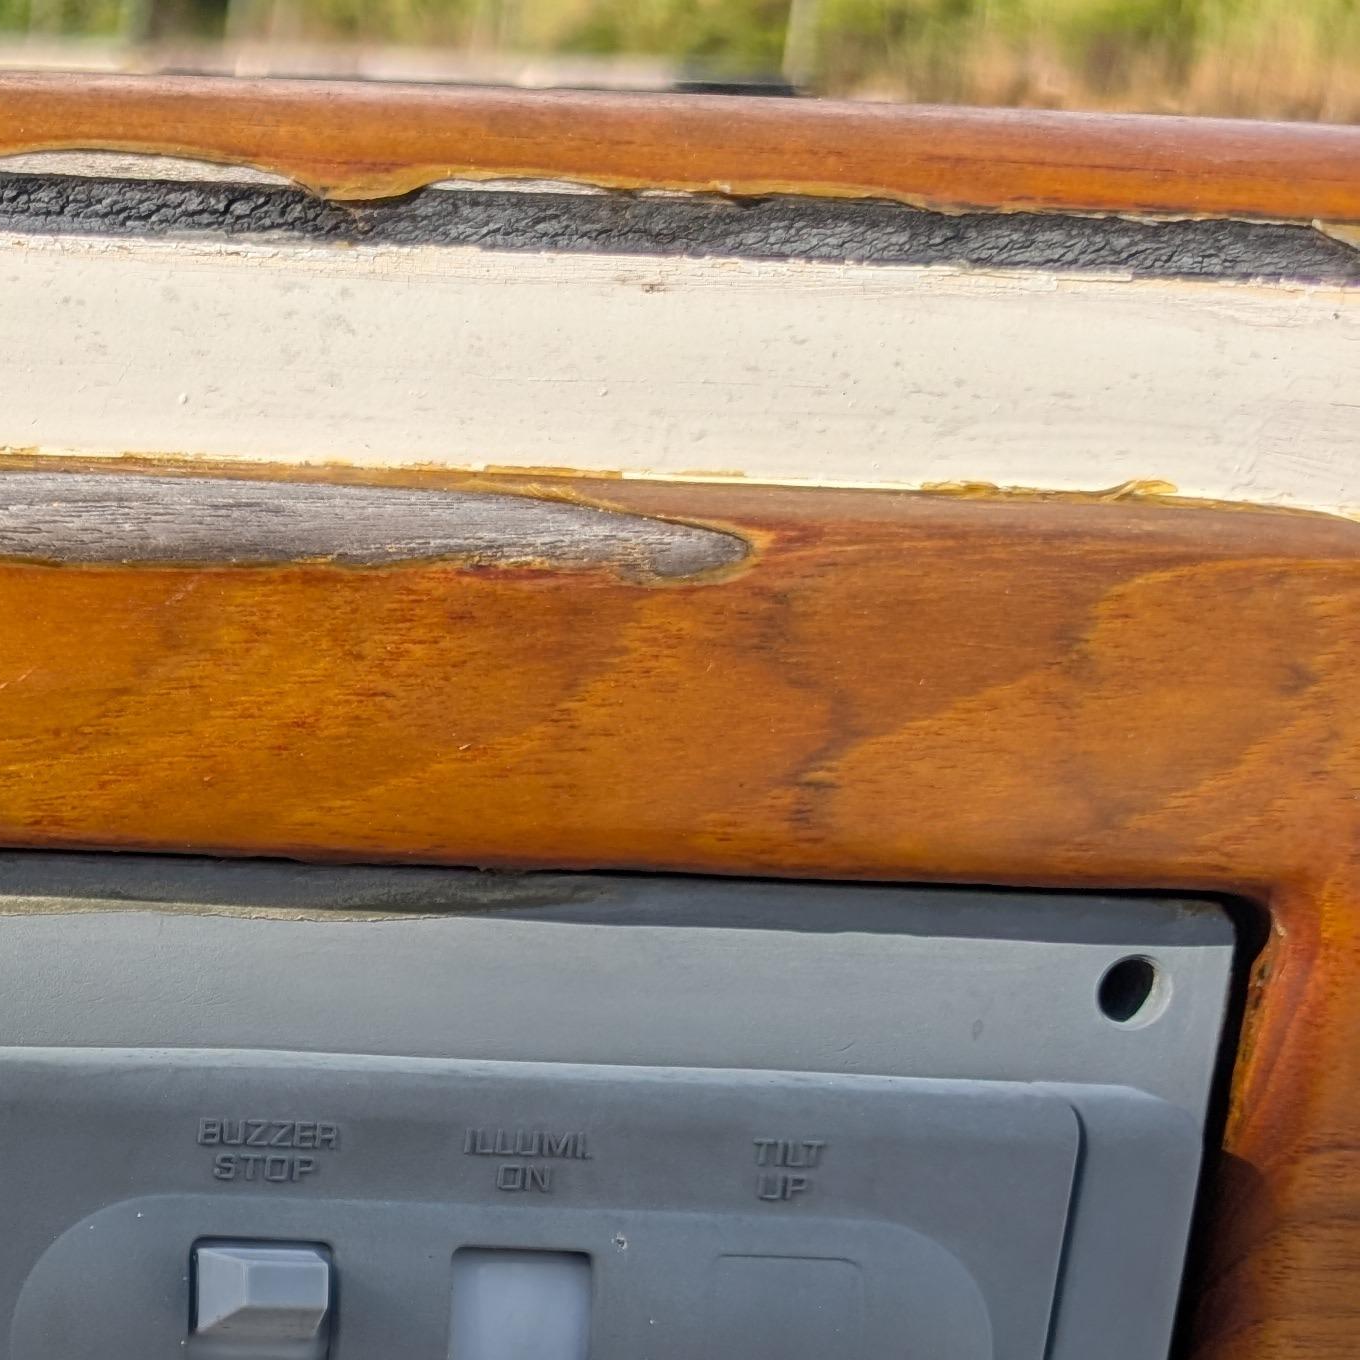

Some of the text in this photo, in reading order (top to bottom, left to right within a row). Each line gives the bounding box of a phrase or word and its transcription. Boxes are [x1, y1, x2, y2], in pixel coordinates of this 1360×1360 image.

[197, 1117, 338, 1149] BUZZER
[213, 1153, 316, 1182] STOP
[753, 1138, 825, 1168] TILT
[496, 1164, 551, 1192] ON
[757, 1174, 807, 1201] UP
